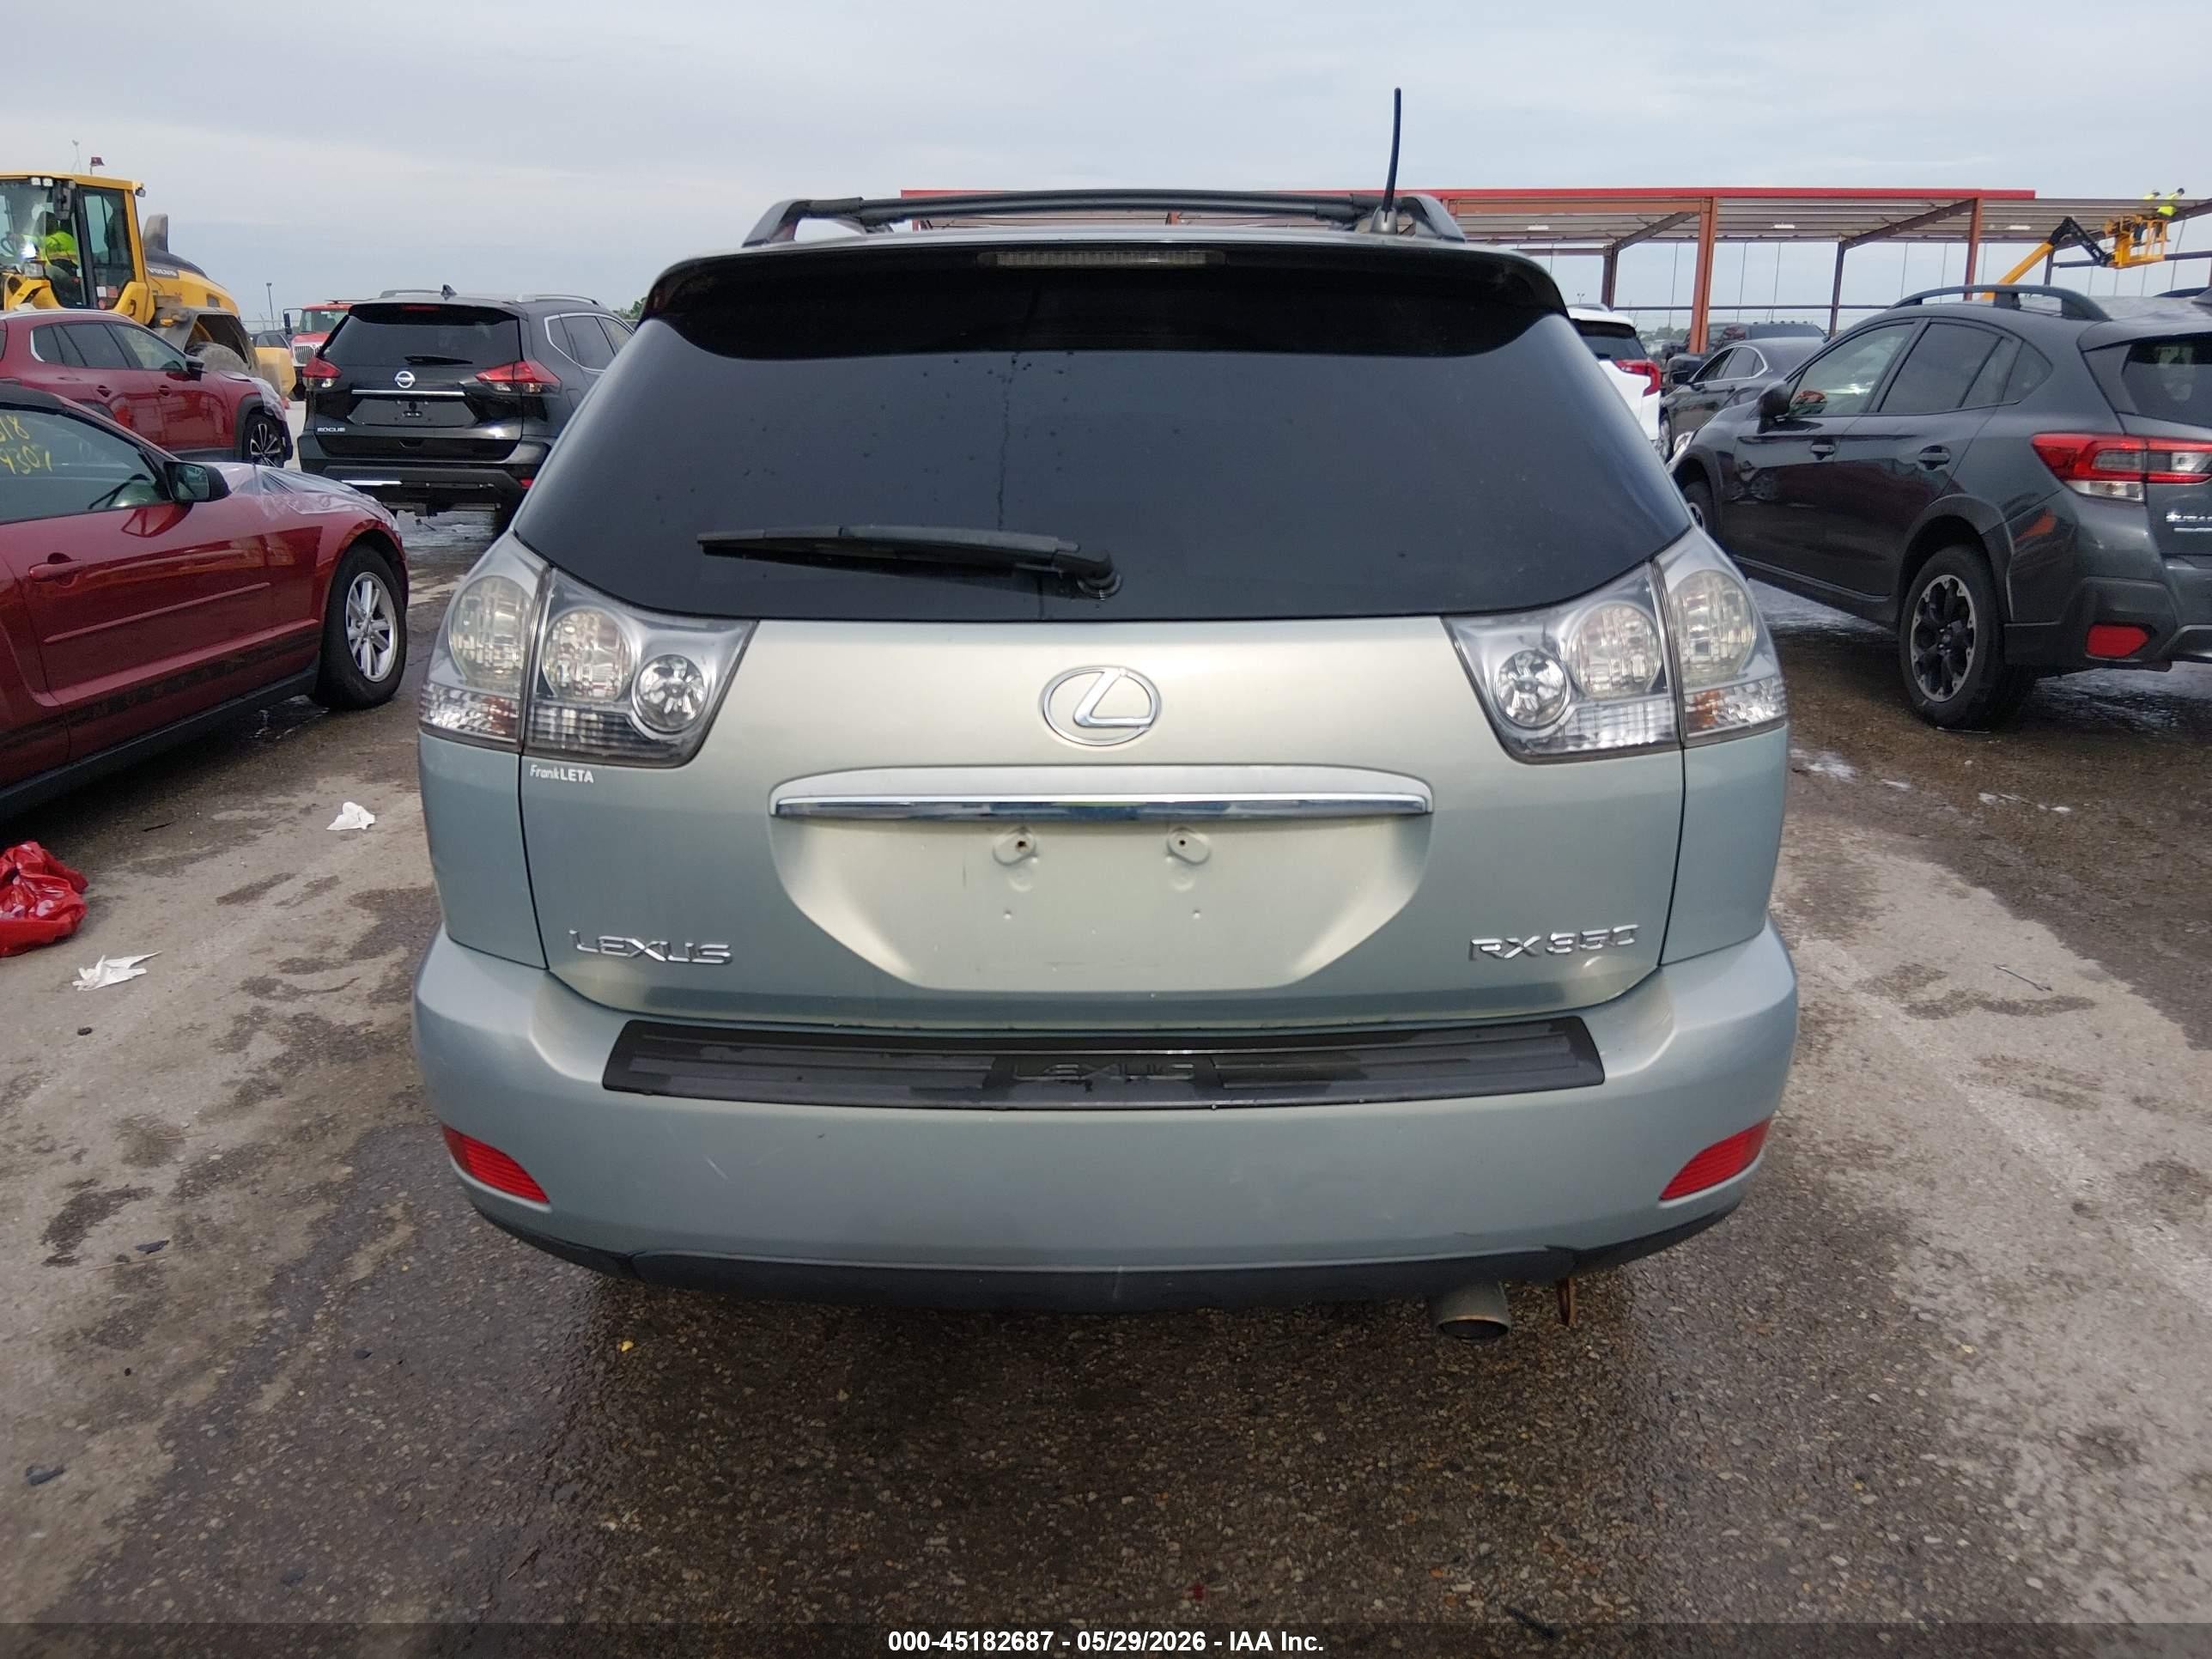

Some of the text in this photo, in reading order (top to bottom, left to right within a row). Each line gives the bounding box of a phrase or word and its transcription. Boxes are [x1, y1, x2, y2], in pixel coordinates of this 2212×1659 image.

[568, 930, 732, 964] LEXUS
[1469, 924, 1638, 961] RX 350
